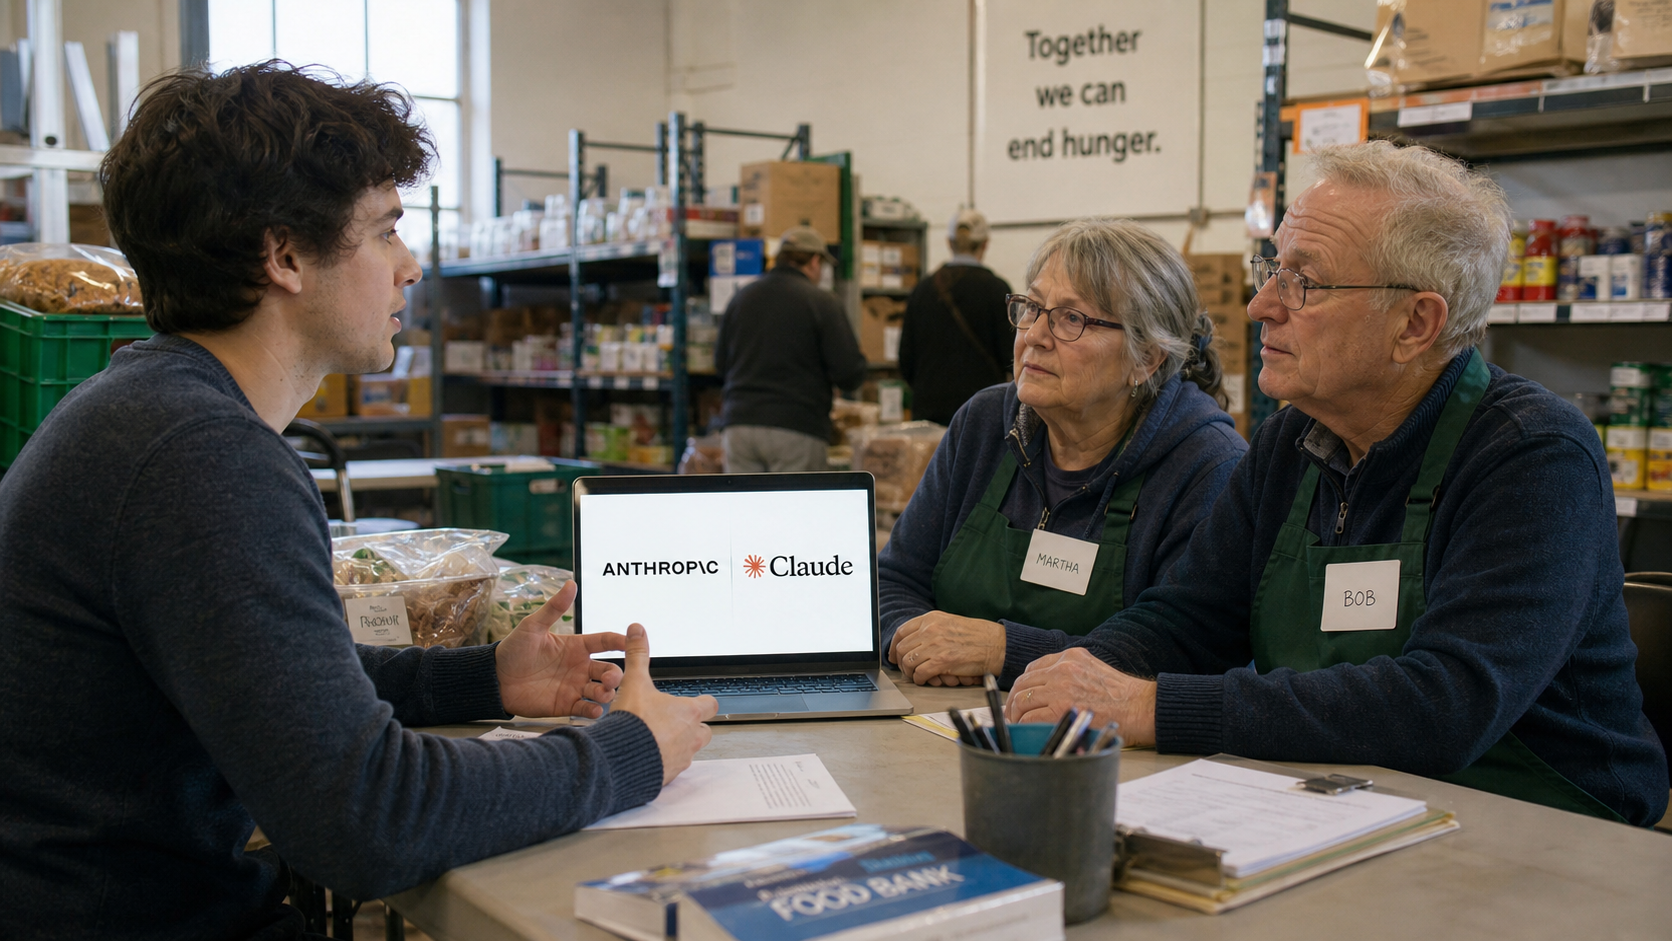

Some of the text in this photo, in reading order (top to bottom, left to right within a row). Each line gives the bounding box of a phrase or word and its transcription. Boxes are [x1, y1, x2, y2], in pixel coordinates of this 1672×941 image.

[1025, 25, 1142, 66] Together
[1036, 82, 1127, 109] we can
[1007, 128, 1162, 164] end hunger.
[769, 554, 854, 577] Claude
[1035, 552, 1080, 575] MARTHA
[1343, 589, 1377, 608] BOB
[770, 882, 871, 922] FOOD
[868, 864, 965, 898] BANK
